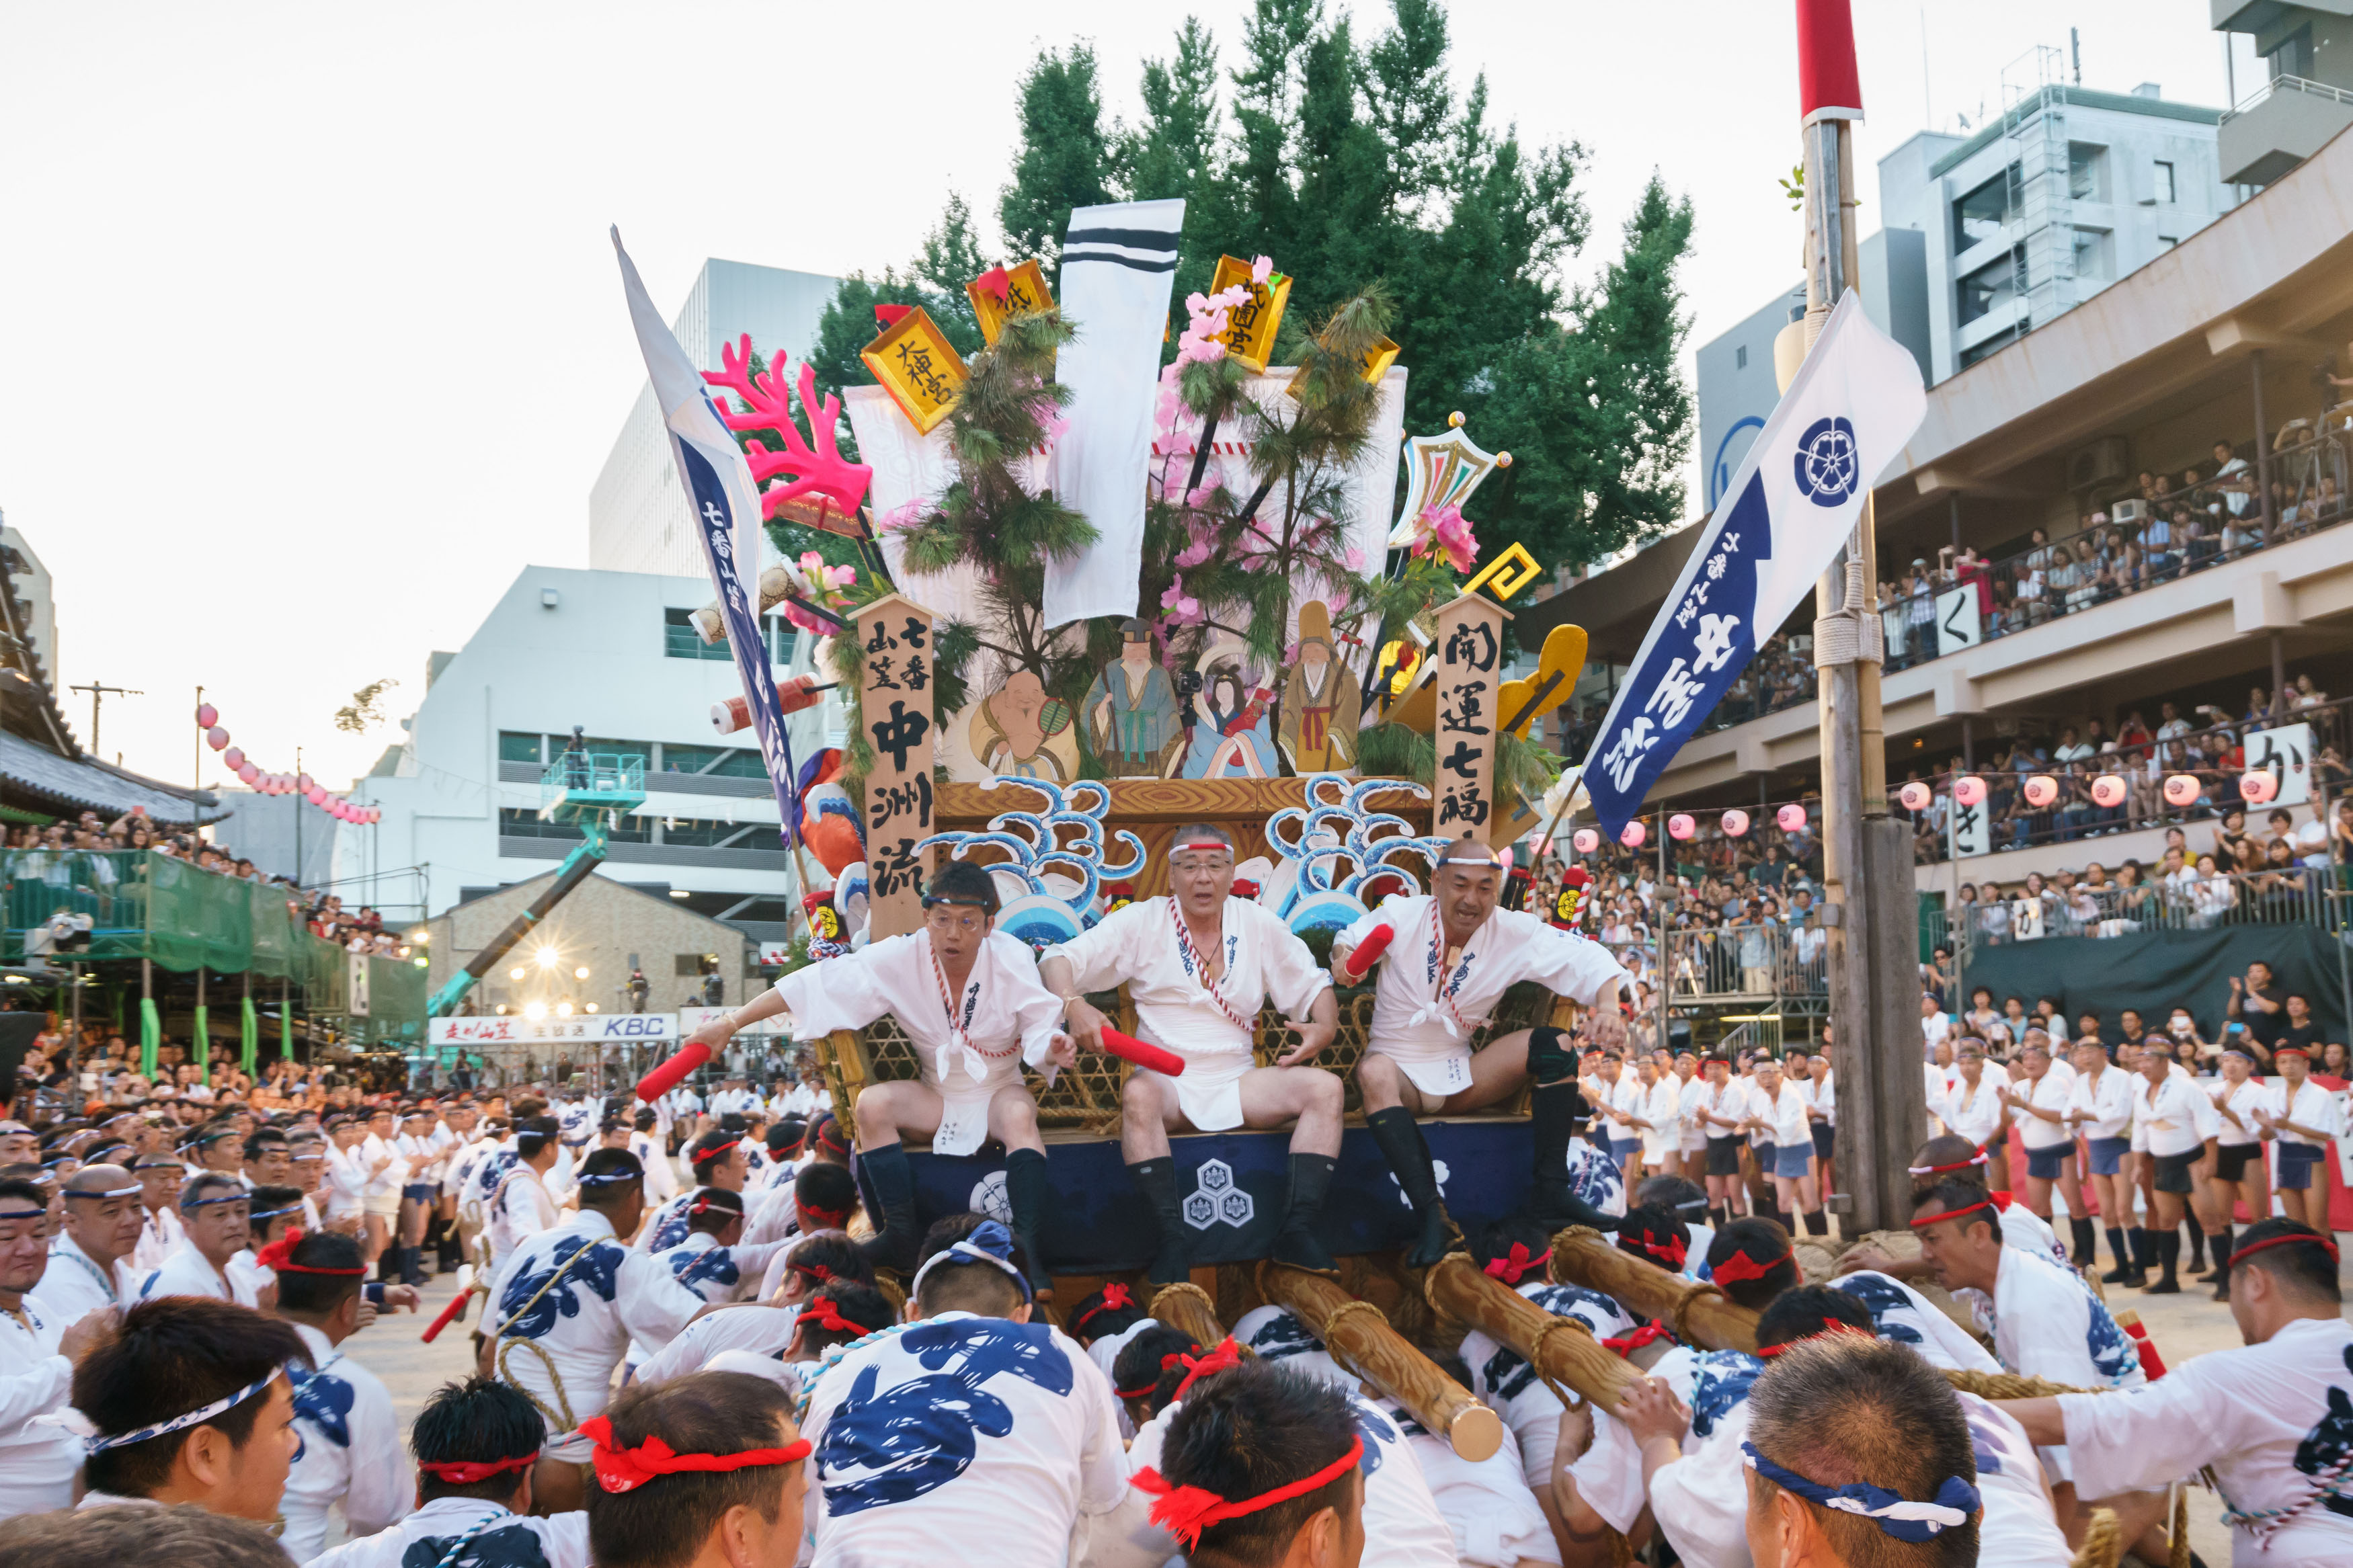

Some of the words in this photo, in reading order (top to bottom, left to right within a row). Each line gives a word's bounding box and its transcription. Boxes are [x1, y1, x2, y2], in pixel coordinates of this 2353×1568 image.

[896, 340, 953, 406] 大神宮
[701, 500, 744, 614] 七番山笠
[900, 616, 930, 692] 七番
[1942, 592, 1970, 645] く
[867, 621, 900, 692] 山笠
[1439, 620, 1498, 839] 開運七福
[871, 700, 933, 897] 中洲流
[2251, 735, 2304, 802] か
[604, 1017, 664, 1036] KBC
